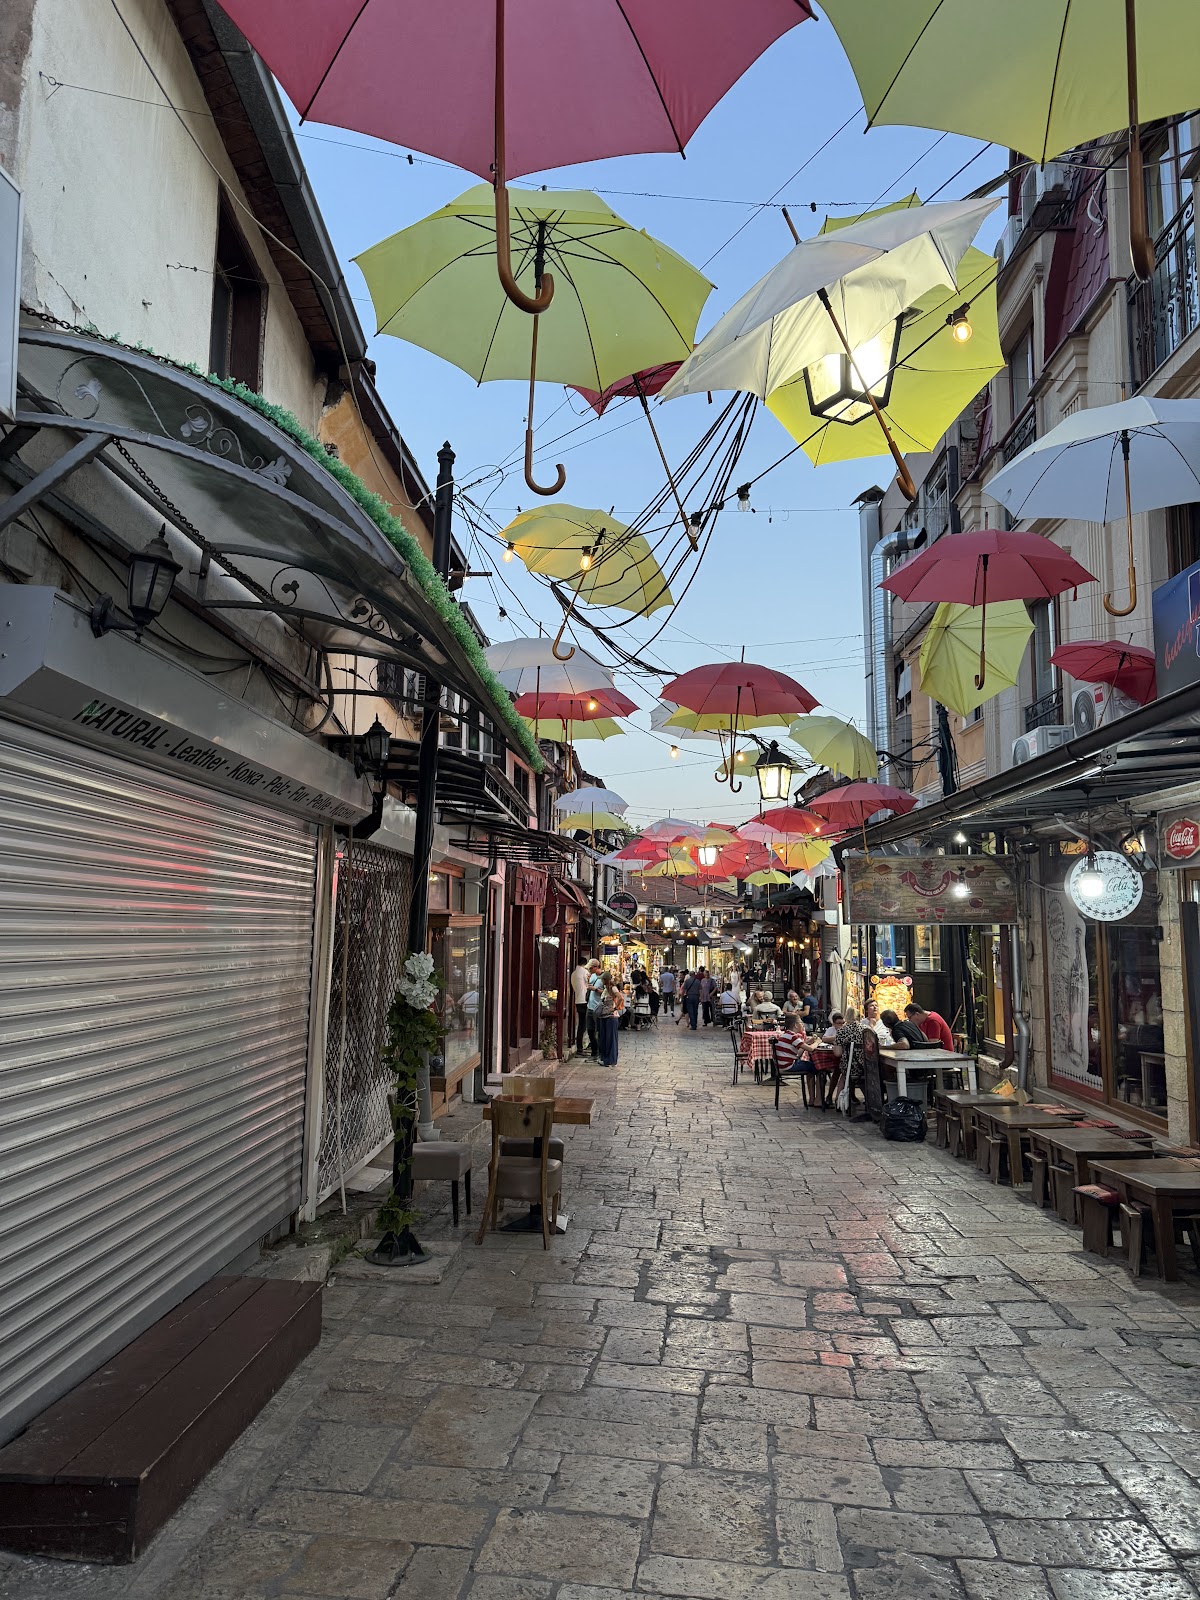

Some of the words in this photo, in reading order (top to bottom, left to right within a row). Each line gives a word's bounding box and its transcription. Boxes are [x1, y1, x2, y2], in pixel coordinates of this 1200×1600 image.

[72, 699, 169, 750] NATURAL
[168, 737, 227, 772] Leather
[263, 775, 291, 796] Pelz
[288, 785, 308, 803] Fur
[306, 793, 332, 811] Pelle
[1105, 875, 1129, 893] Cola
